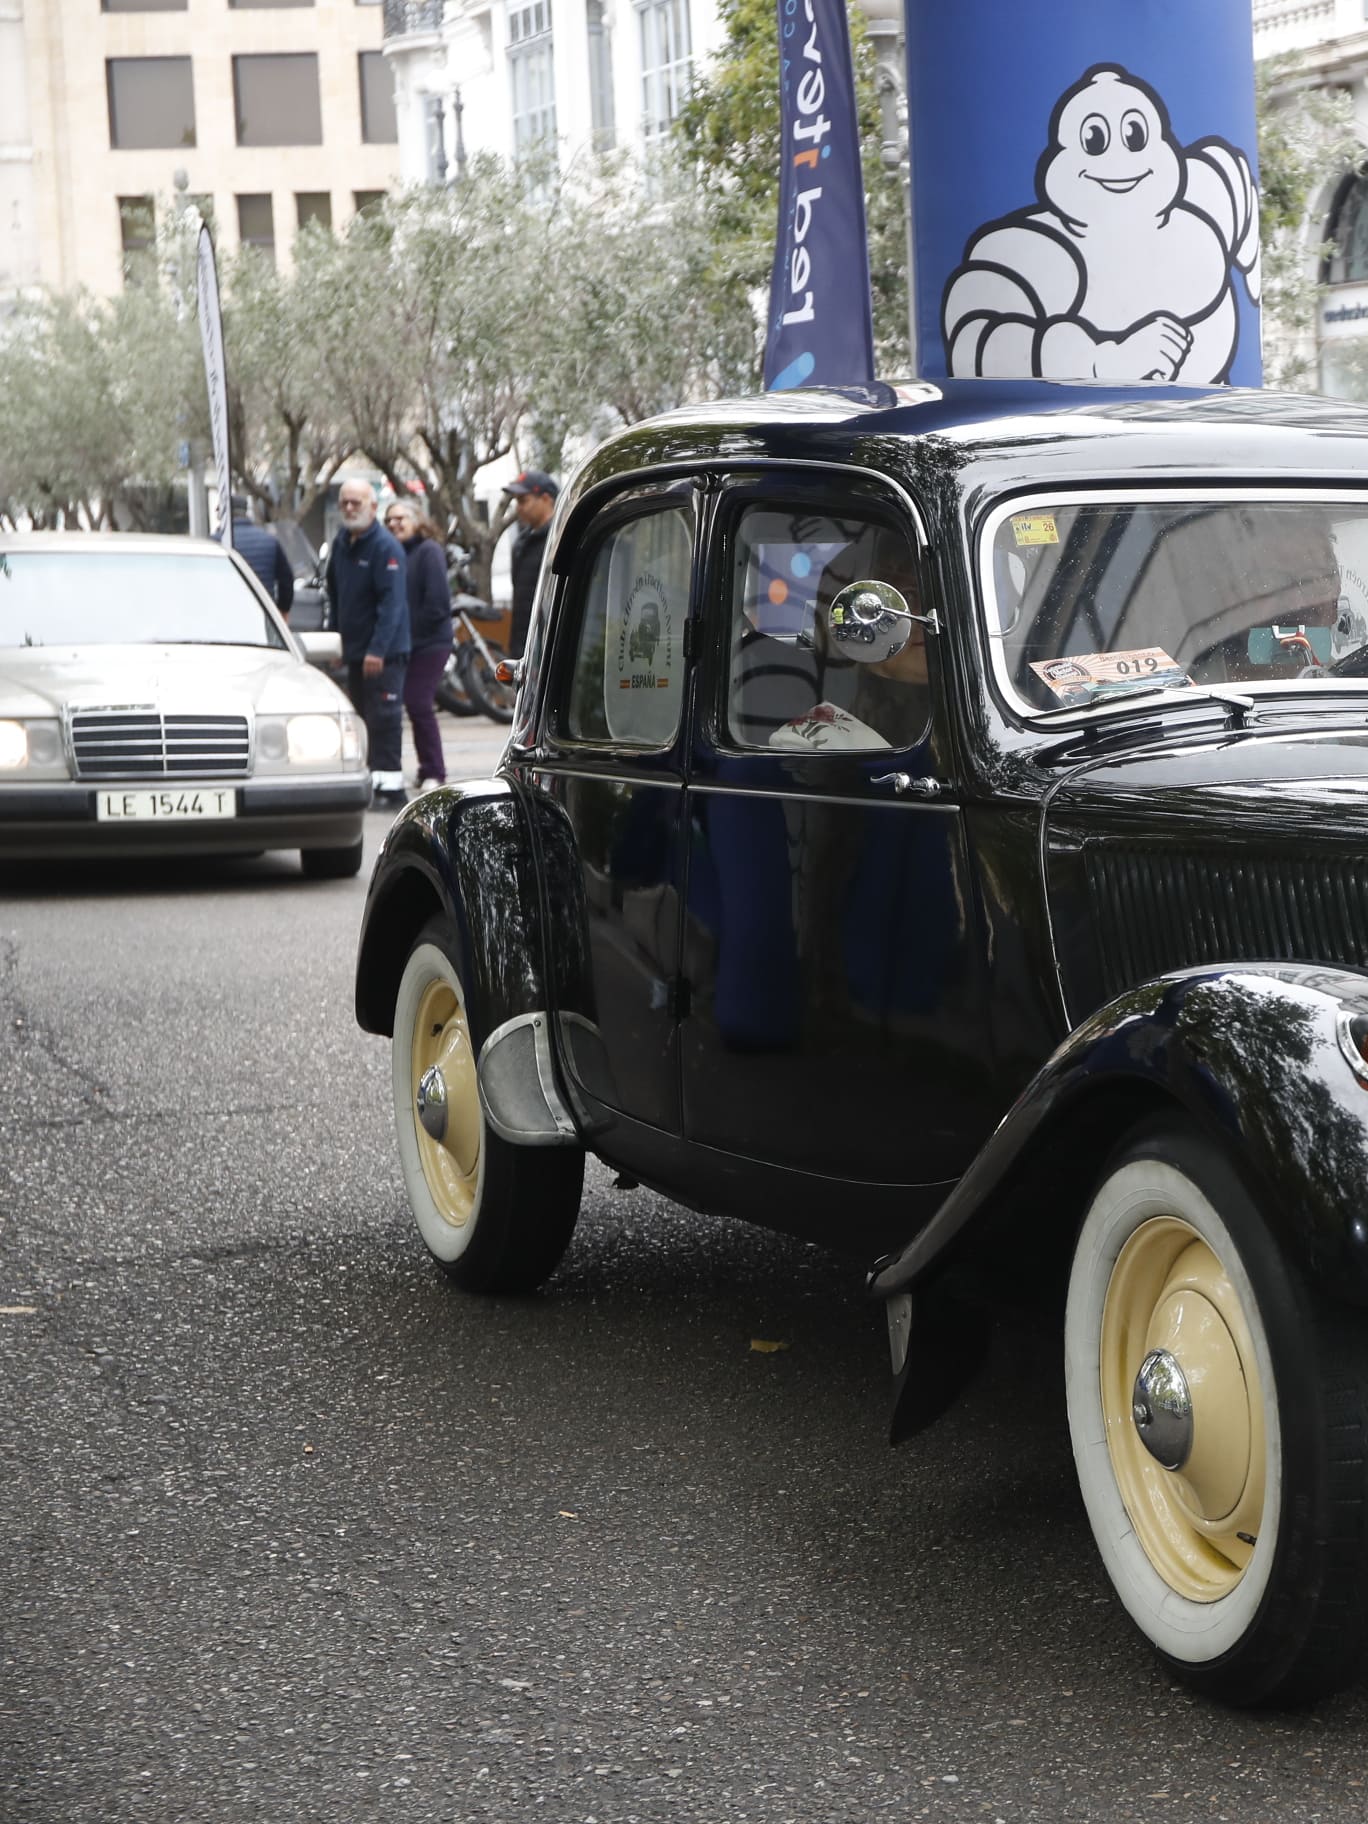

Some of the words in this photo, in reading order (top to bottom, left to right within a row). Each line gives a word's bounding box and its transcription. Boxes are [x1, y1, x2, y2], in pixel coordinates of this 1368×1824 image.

[1043, 522, 1056, 534] 26
[1116, 657, 1158, 675] 019
[631, 670, 656, 689] ESPAÑA
[106, 794, 136, 816] LE
[150, 793, 203, 815] 1544
[214, 791, 225, 813] T
